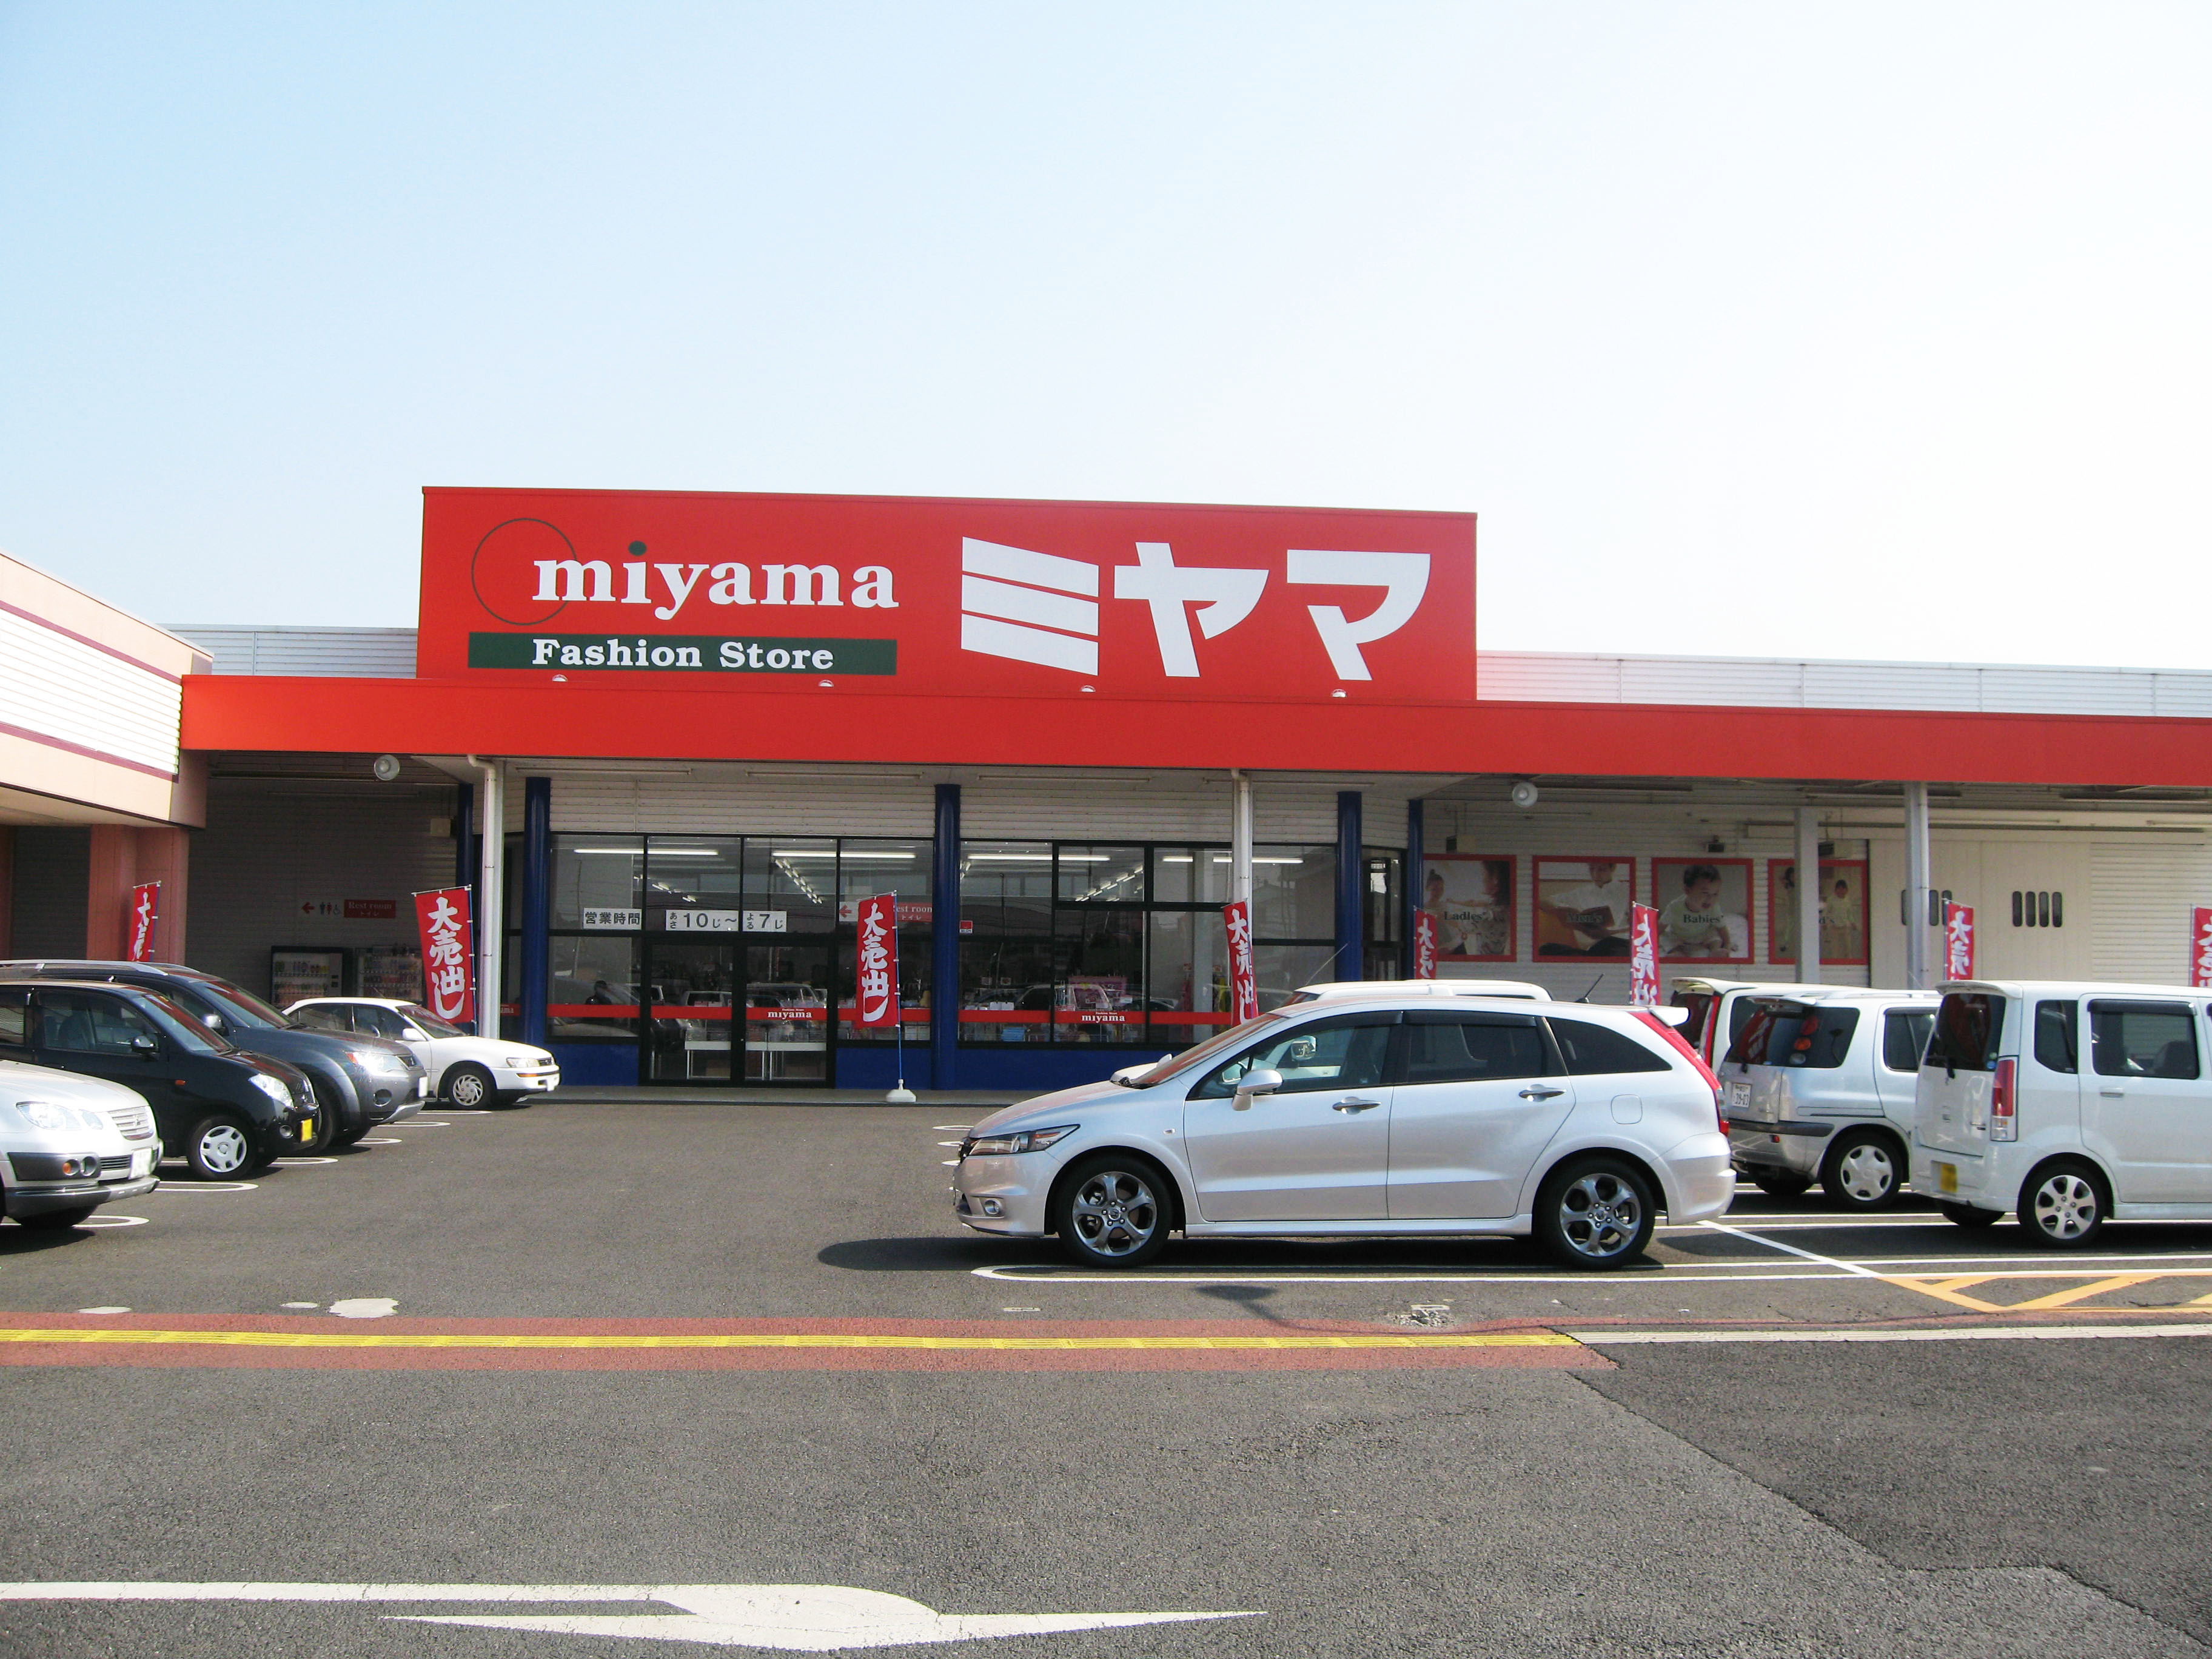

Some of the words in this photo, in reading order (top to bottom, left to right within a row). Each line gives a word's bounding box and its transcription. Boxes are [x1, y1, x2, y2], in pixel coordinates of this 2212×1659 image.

[532, 540, 899, 620] miyama
[961, 536, 1431, 681] ミヤマ
[532, 638, 703, 668] Fashion
[720, 640, 834, 670] Store
[585, 911, 640, 925] 営業時間
[1683, 914, 1724, 923] Babies'
[427, 897, 466, 1019] 大売出し
[861, 902, 889, 1022] 大売出し
[1082, 1015, 1125, 1024] miyama
